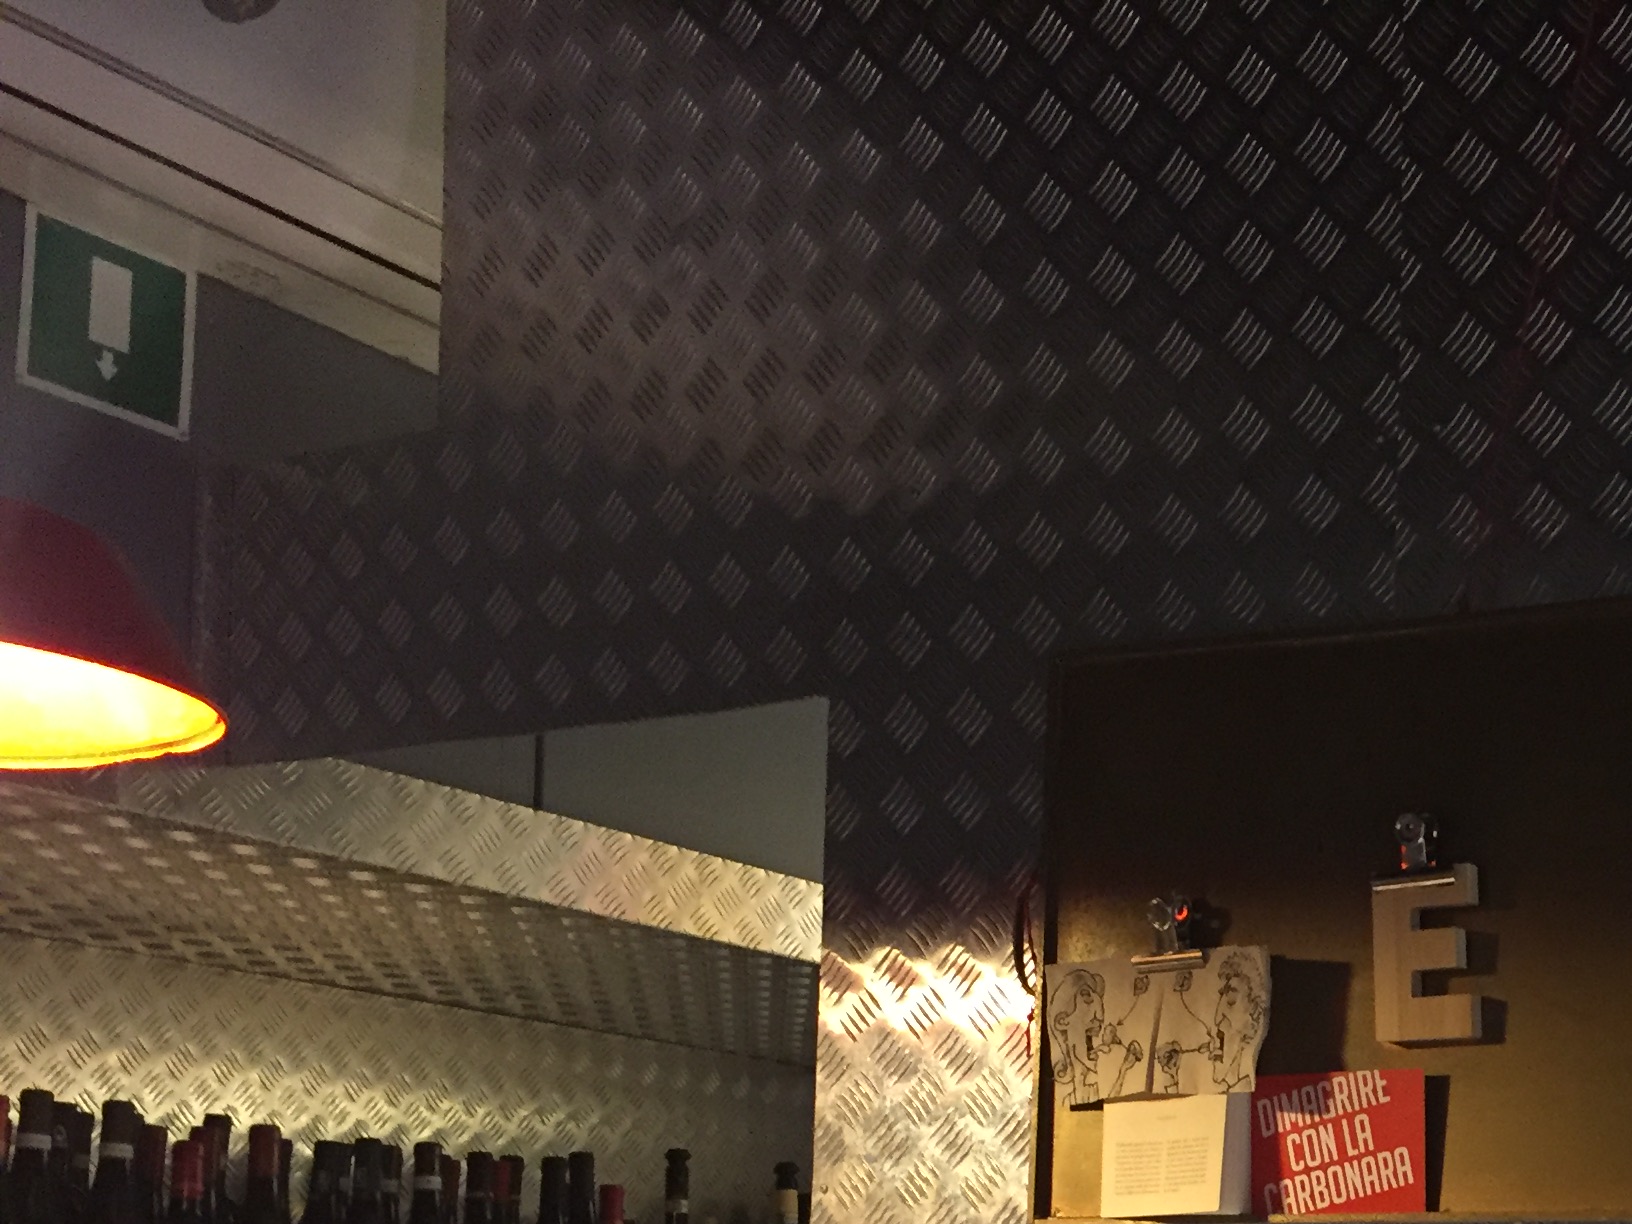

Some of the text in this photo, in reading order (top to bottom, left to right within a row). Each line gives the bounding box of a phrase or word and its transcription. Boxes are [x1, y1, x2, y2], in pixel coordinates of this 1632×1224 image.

[1257, 1069, 1391, 1138] DIMAGRIRE
[1286, 1113, 1374, 1172] CON LA
[1264, 1146, 1414, 1215] CARBONARA
